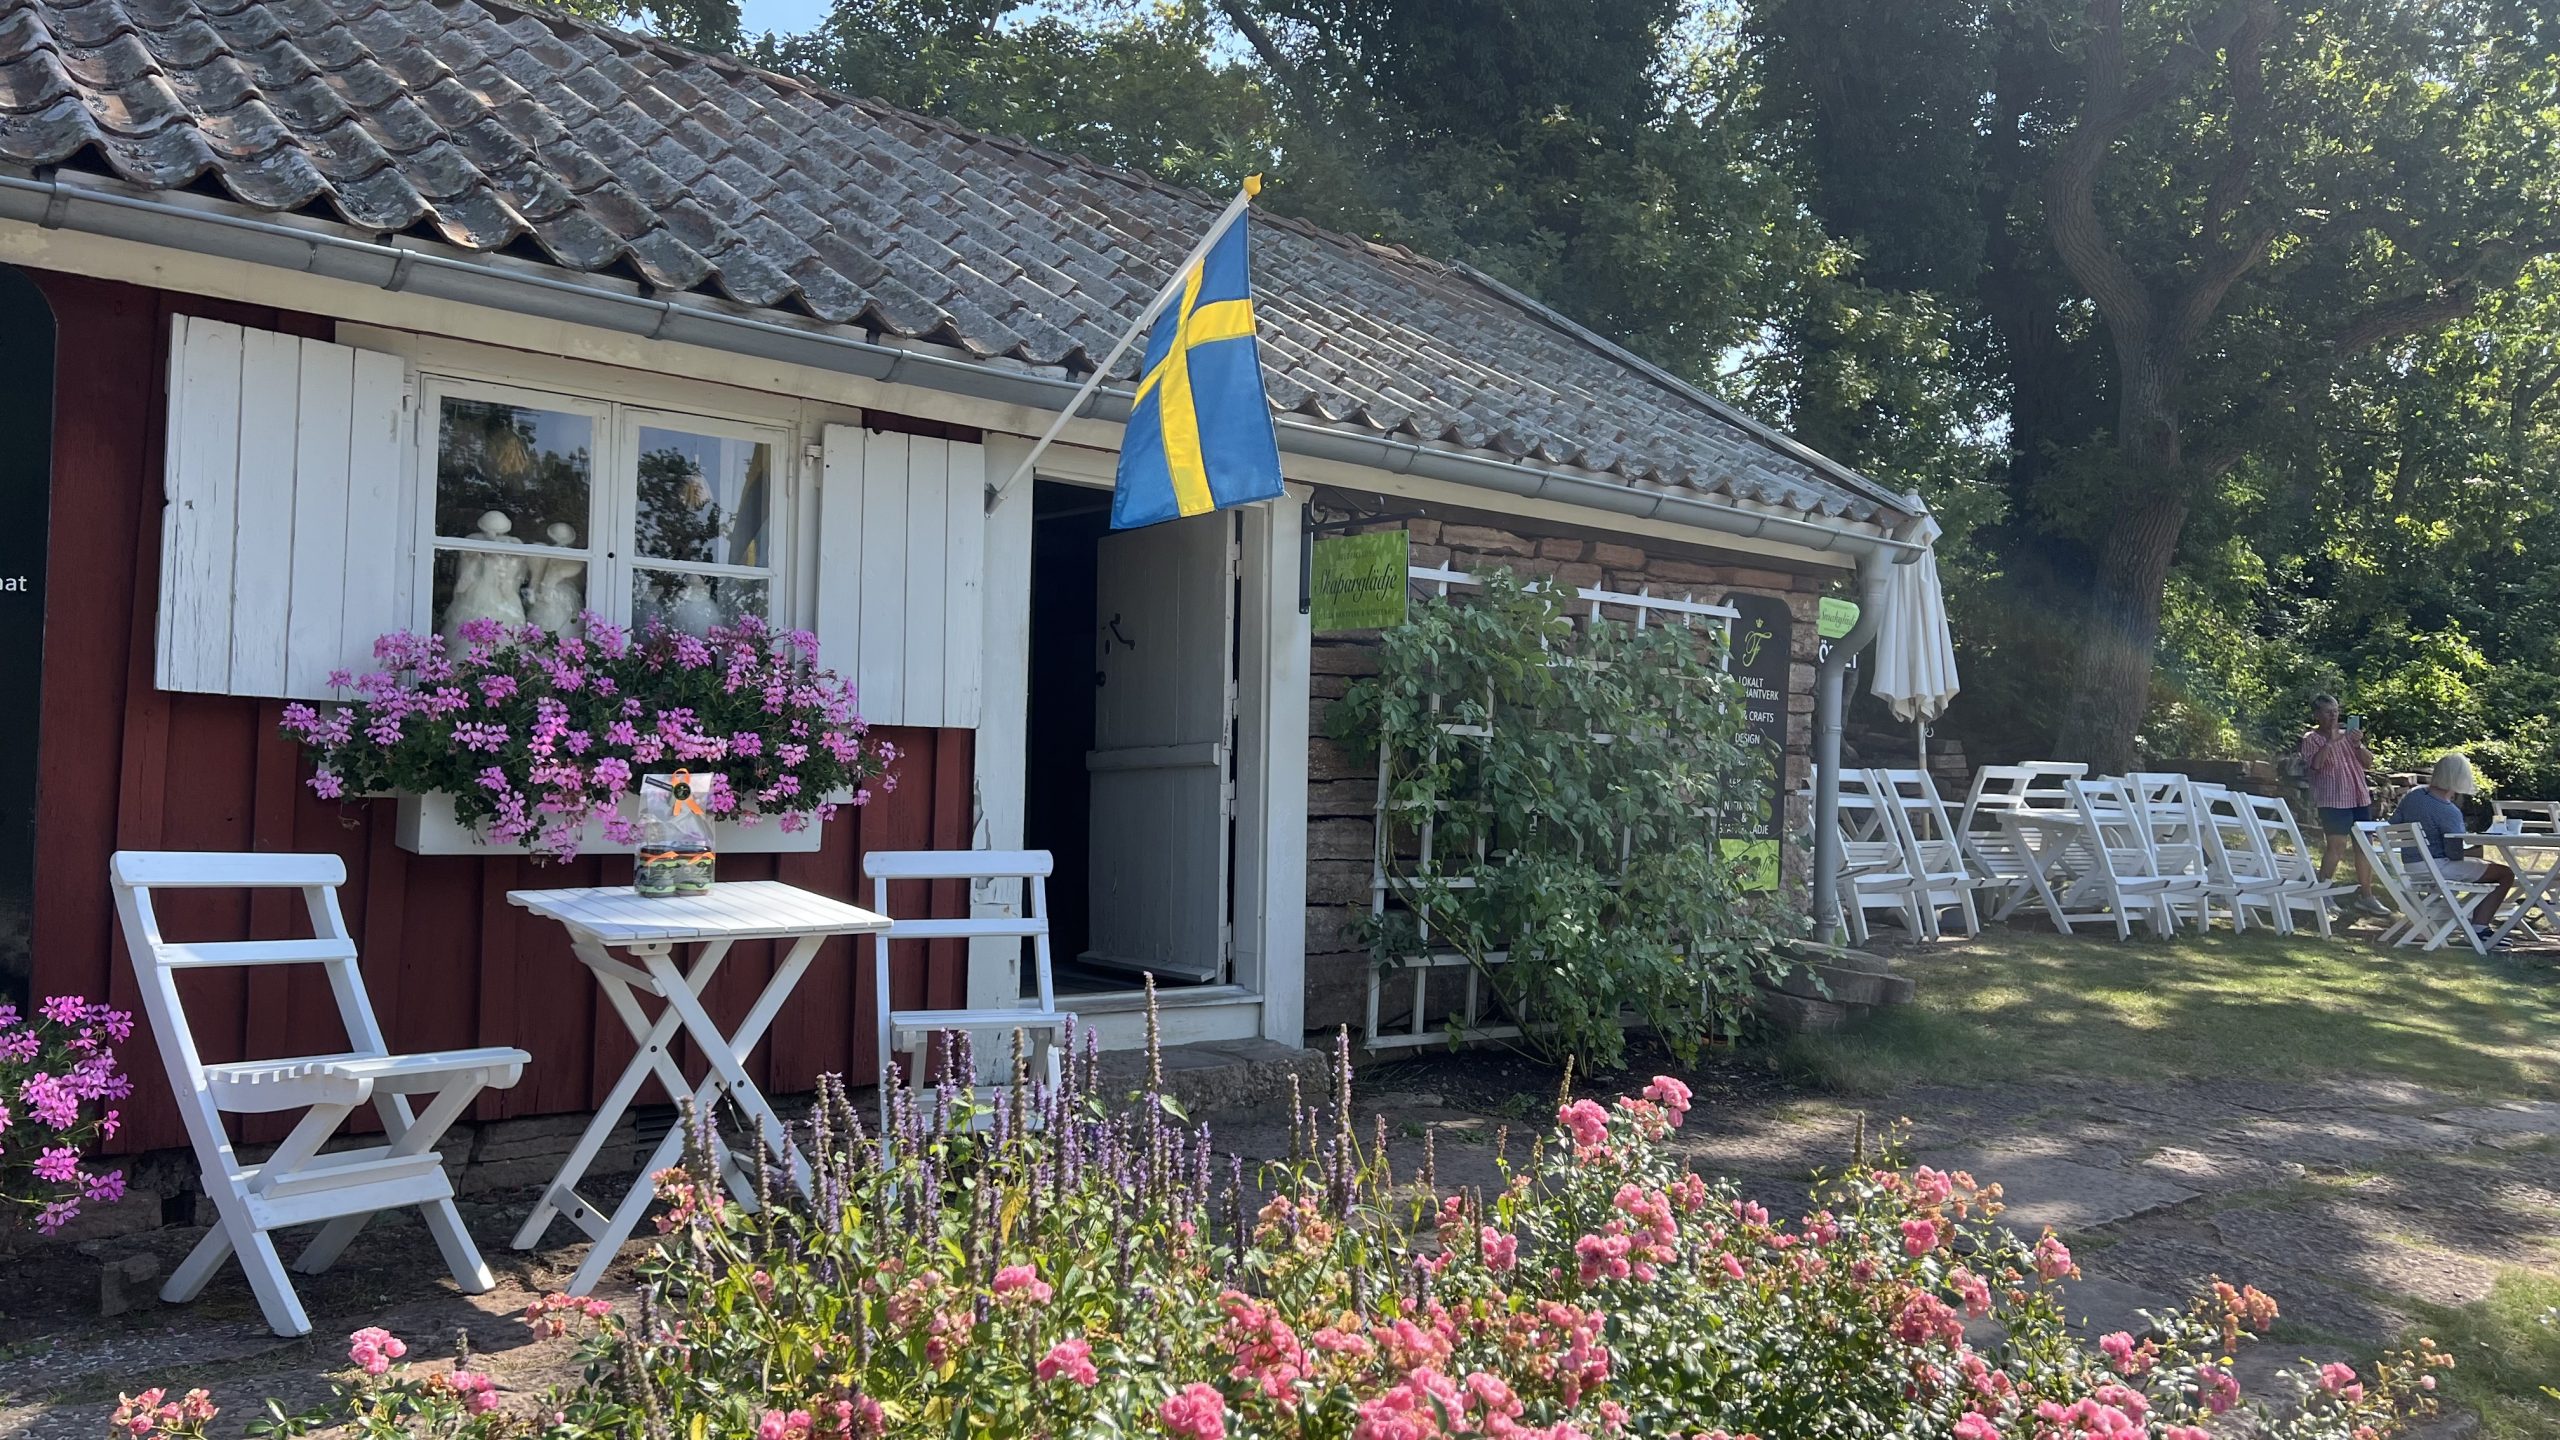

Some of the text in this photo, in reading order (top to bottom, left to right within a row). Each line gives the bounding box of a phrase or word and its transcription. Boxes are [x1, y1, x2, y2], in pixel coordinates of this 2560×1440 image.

[1314, 563, 1398, 606] Skaparglädje
[1748, 710, 1775, 723] CRAFTS
[1734, 732, 1761, 745] DESIGN
